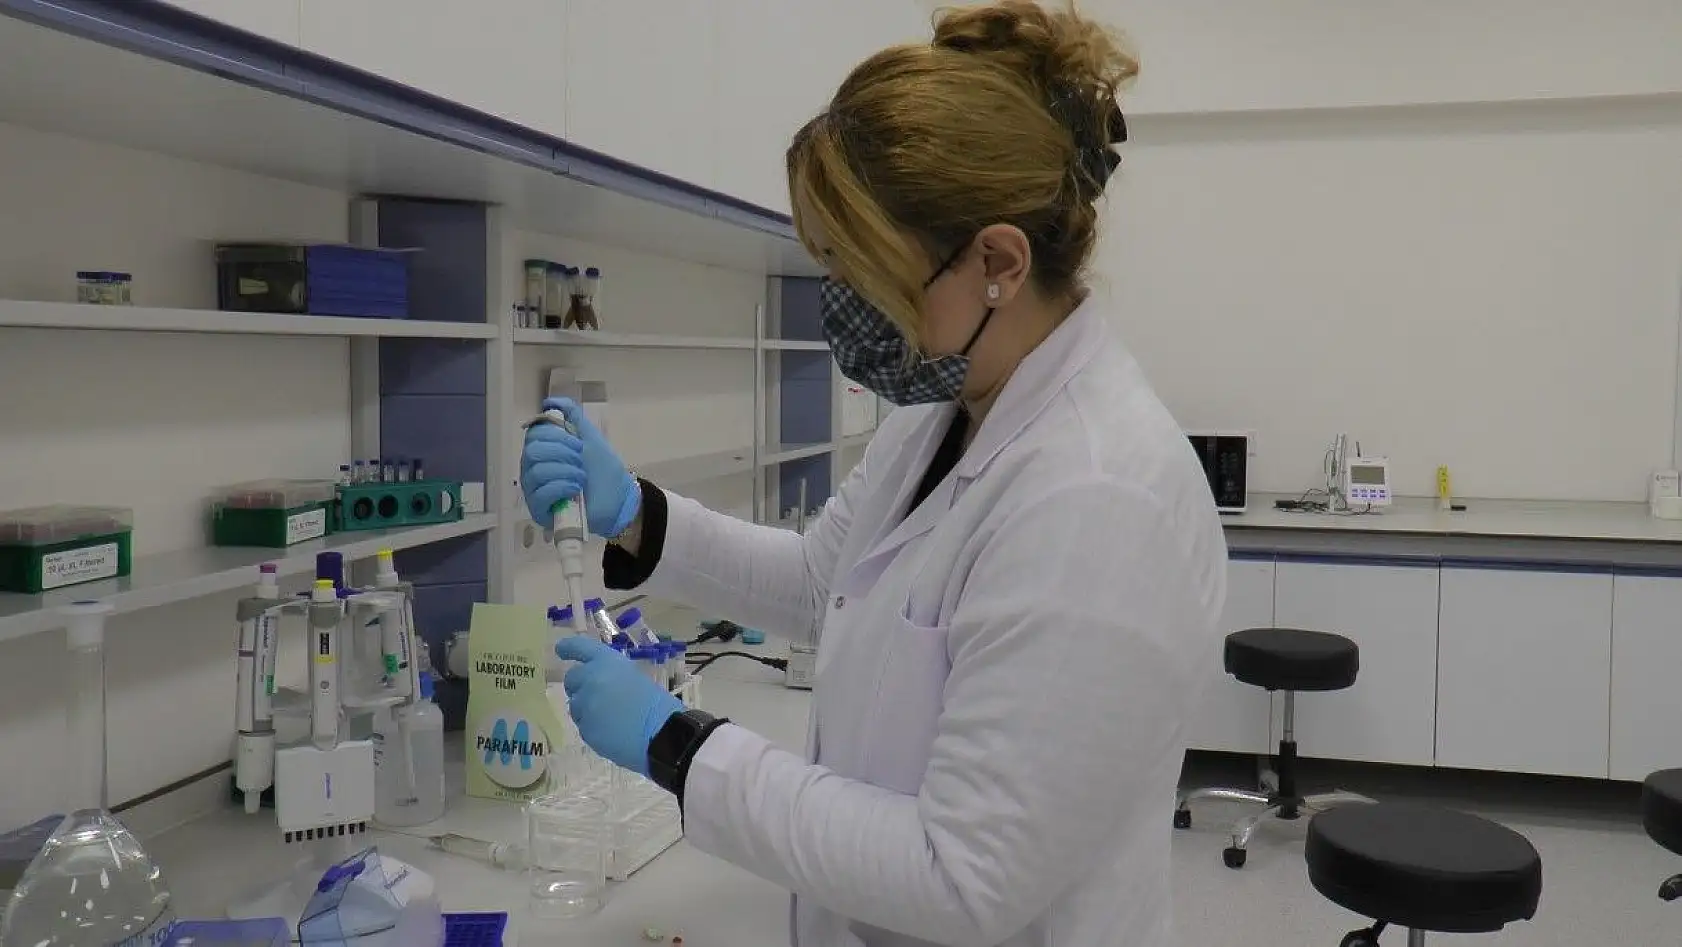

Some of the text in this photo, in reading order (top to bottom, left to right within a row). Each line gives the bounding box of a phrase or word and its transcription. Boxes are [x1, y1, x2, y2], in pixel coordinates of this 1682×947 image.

[476, 660, 536, 678] LABORATORY
[495, 677, 516, 690] FILM
[476, 735, 544, 756] PARAFILM
